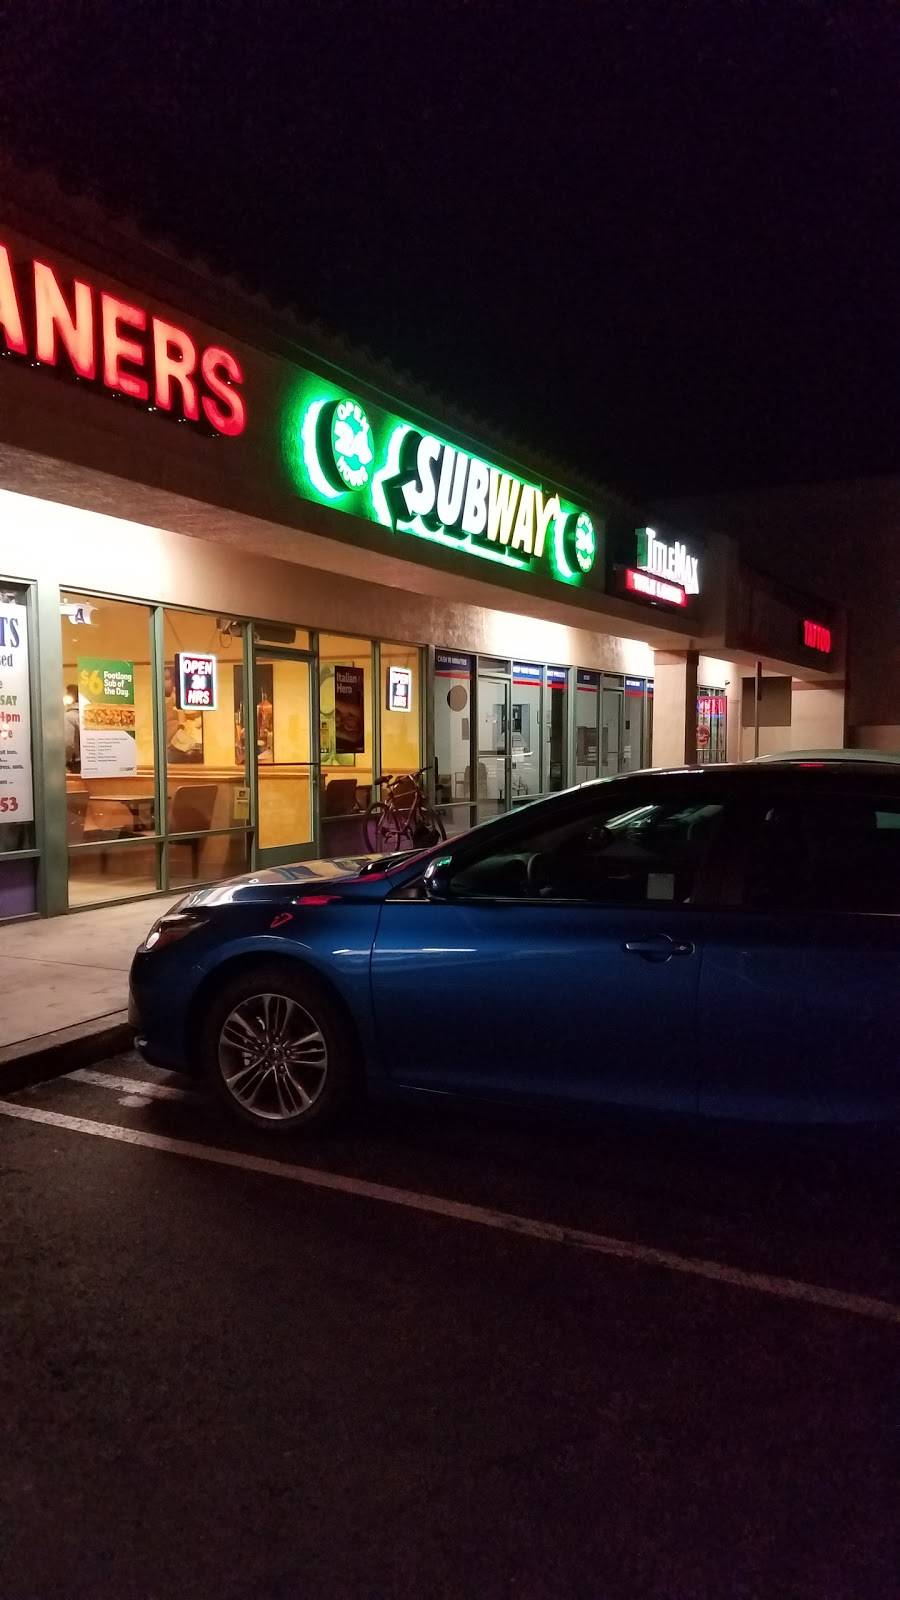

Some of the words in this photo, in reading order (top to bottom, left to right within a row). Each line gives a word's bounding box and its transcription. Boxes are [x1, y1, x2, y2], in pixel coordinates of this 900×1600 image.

[401, 434, 560, 558] SUBWAY
[0, 654, 13, 667] ed
[183, 659, 212, 675] OPEN
[103, 671, 132, 682] Footlong
[336, 672, 358, 683] Italian
[104, 679, 116, 688] Sub
[104, 687, 115, 695] the
[188, 690, 210, 704] HRS
